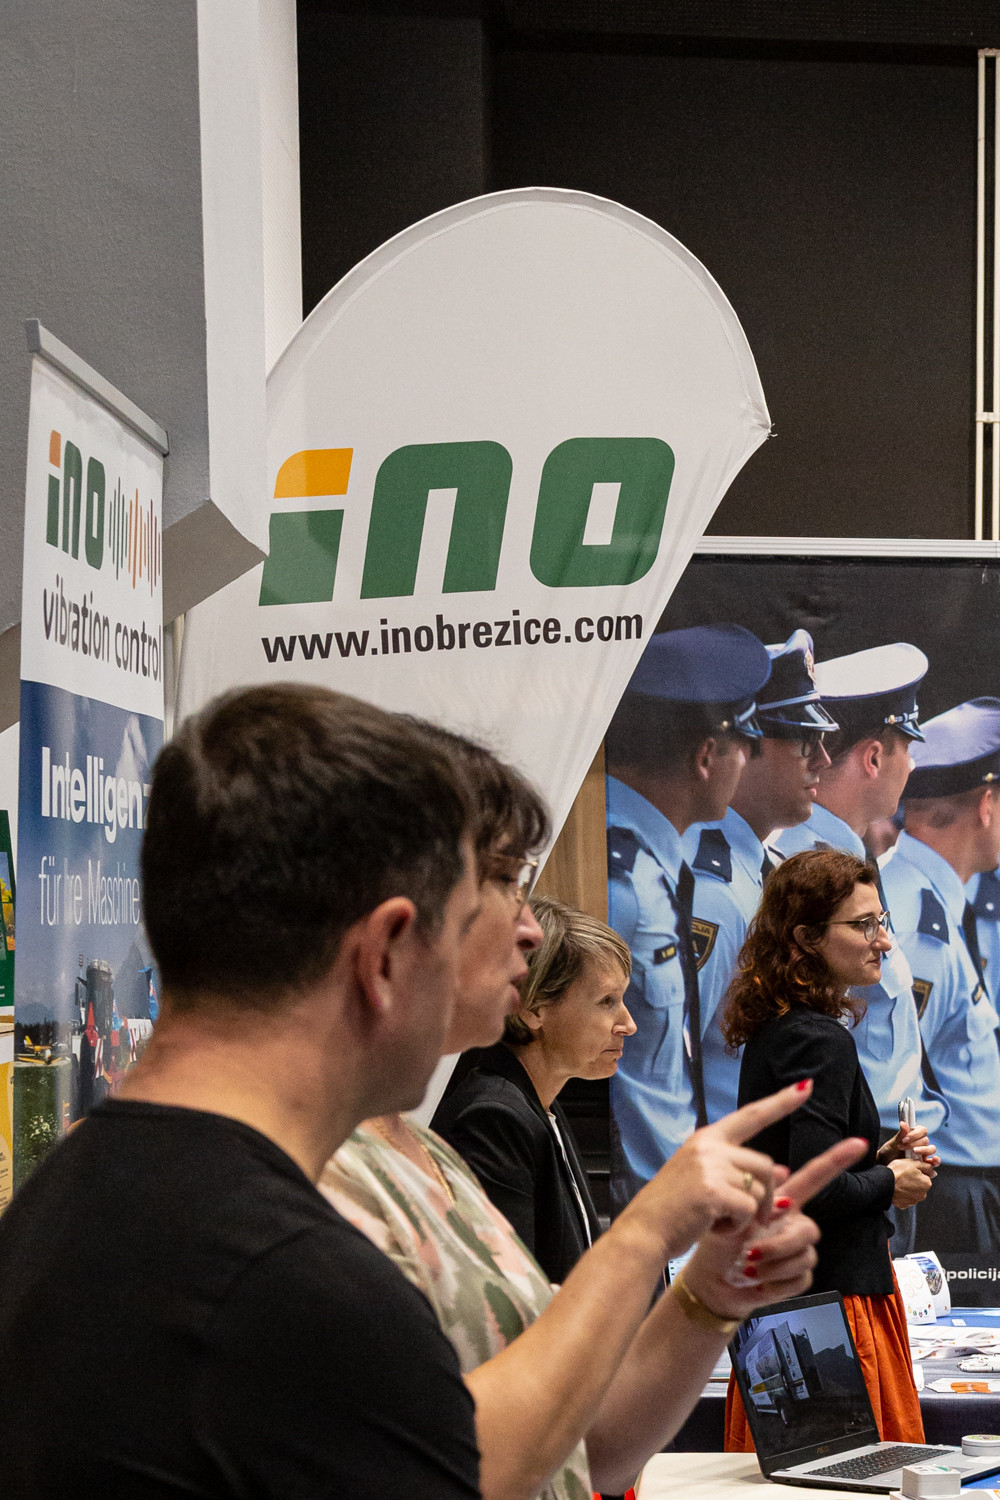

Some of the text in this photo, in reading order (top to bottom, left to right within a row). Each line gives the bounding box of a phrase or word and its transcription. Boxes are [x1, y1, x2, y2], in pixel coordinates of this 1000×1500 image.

[46, 429, 106, 570] ino
[258, 437, 676, 607] ino
[43, 573, 162, 683] vibration control
[261, 609, 643, 663] www.inobrezice.com
[38, 855, 62, 926] für
